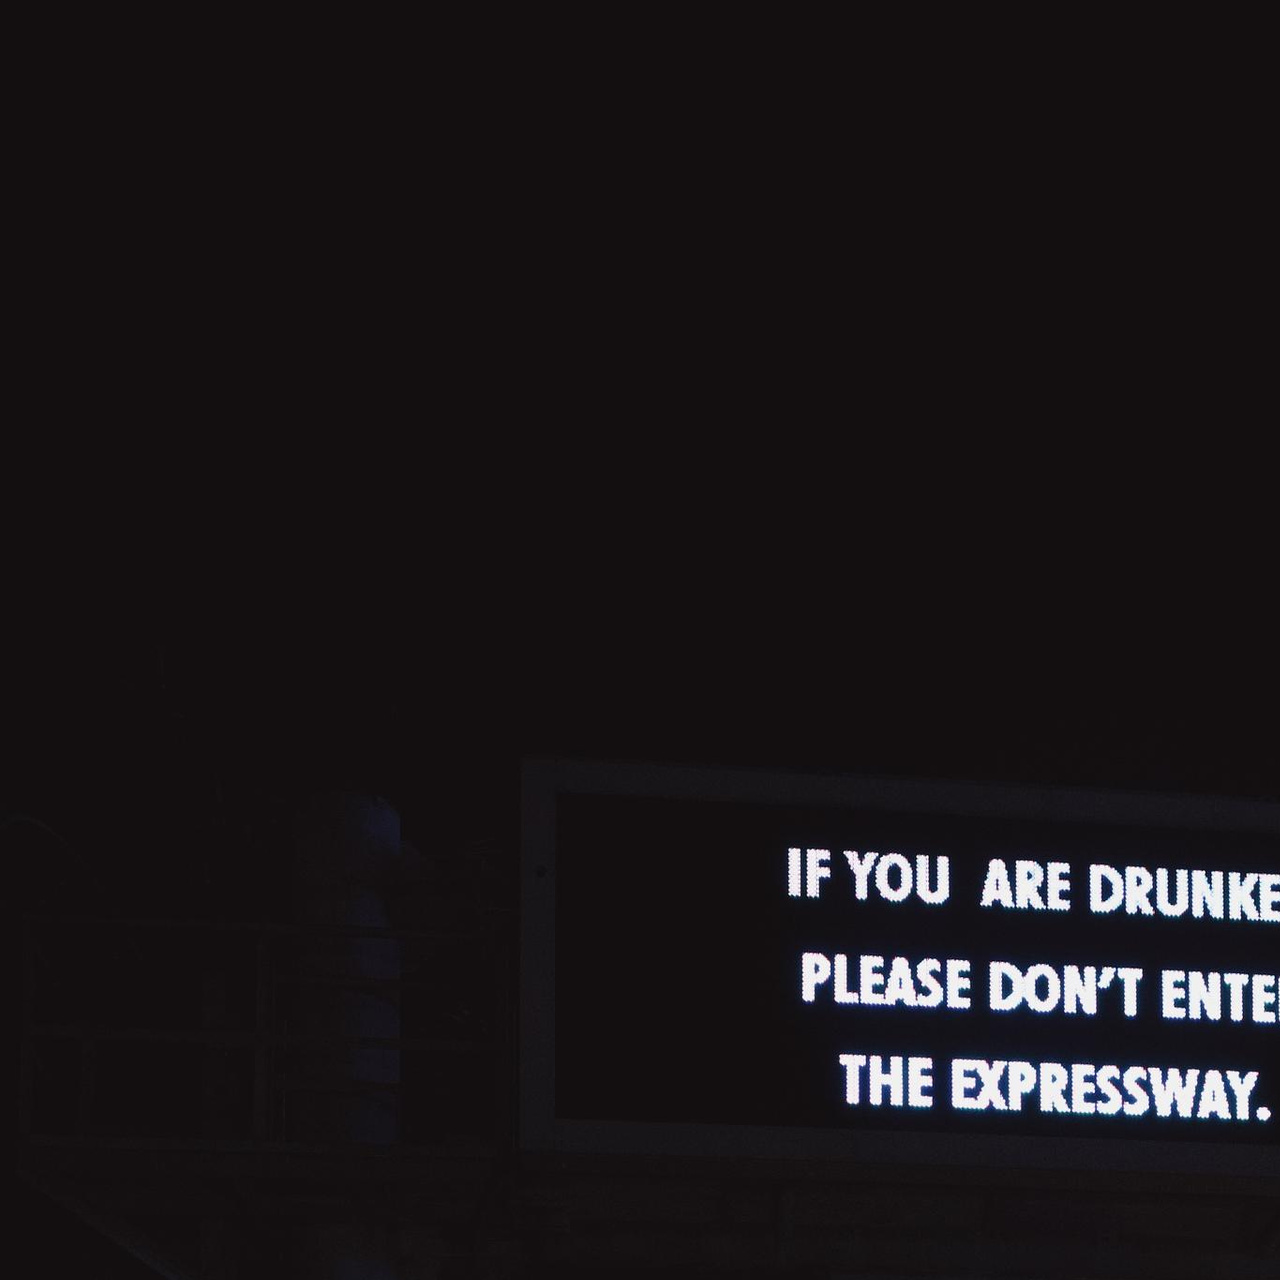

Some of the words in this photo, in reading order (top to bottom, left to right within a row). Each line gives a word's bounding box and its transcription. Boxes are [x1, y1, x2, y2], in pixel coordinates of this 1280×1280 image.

[788, 847, 831, 898] IF
[843, 850, 949, 904] YOU
[981, 858, 1071, 911] ARE
[801, 952, 971, 1010] PLEASE
[989, 960, 1144, 1017] DON'T
[839, 1053, 933, 1108] THE
[951, 1058, 1272, 1121] EXPRESSWAY.
